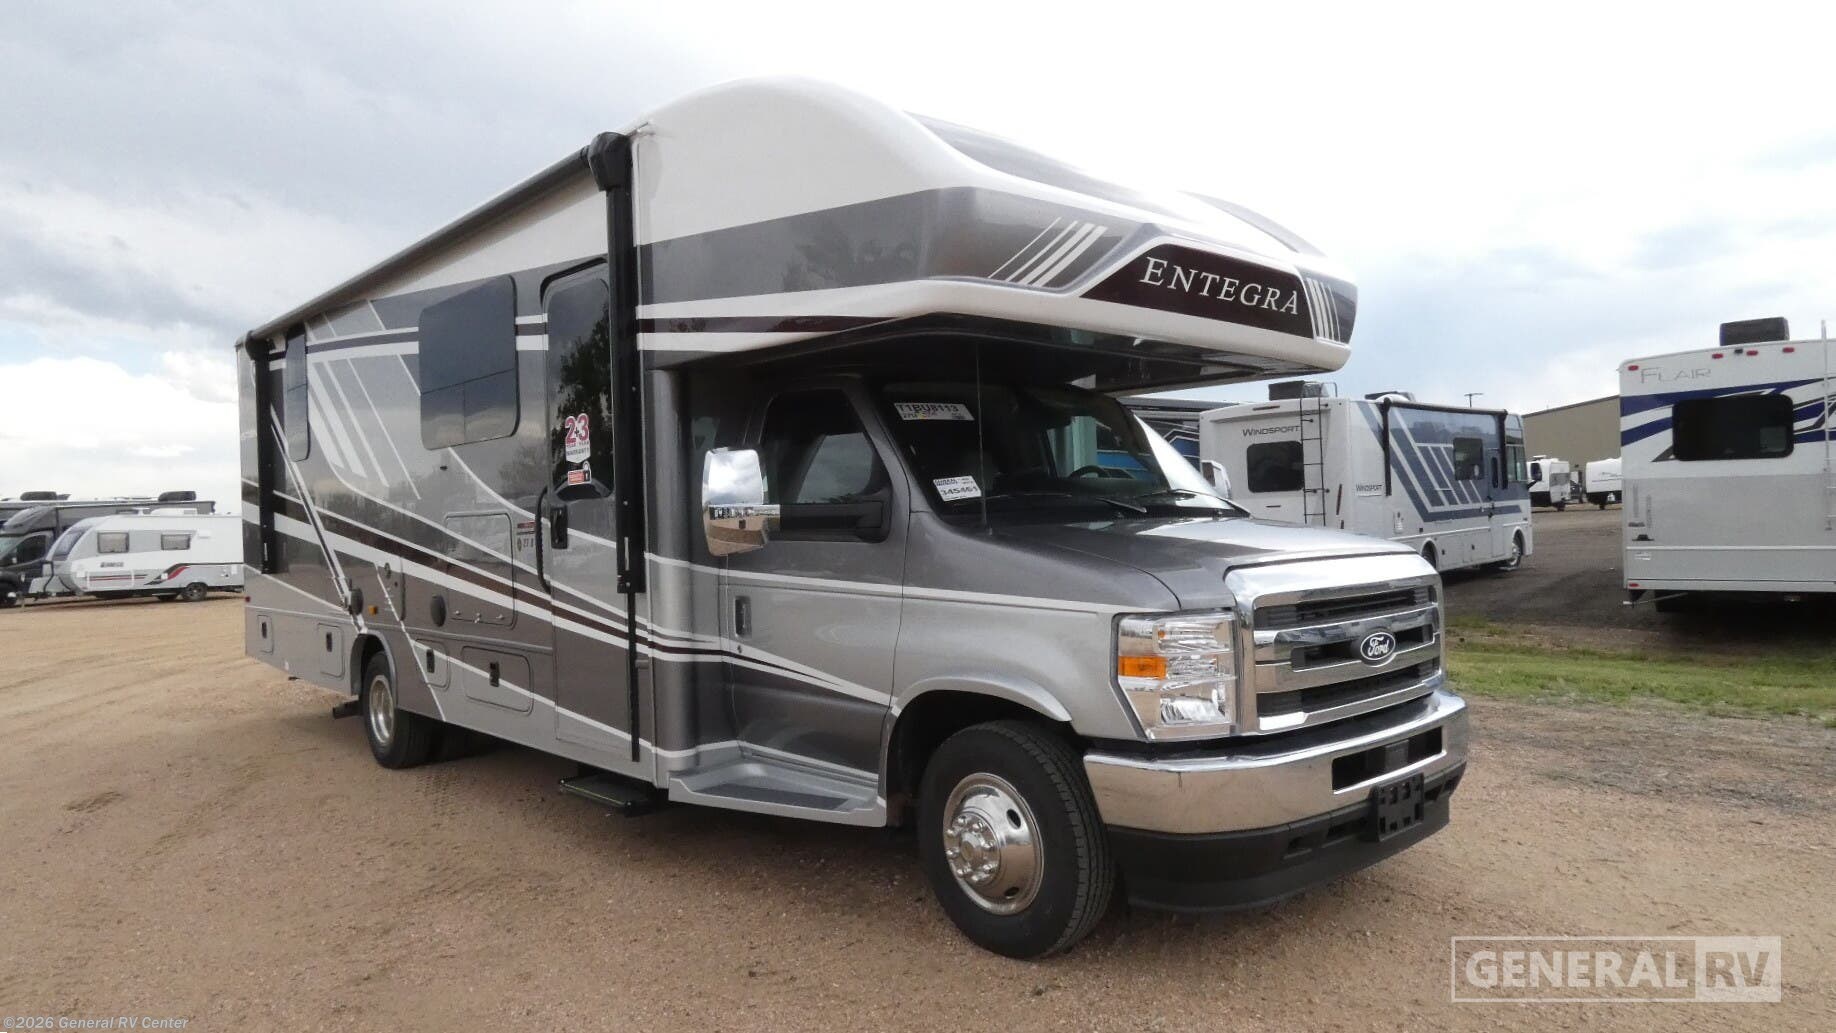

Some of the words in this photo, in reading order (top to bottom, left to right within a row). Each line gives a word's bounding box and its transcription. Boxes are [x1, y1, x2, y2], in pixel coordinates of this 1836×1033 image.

[1139, 256, 1298, 315] ENTEGRA
[1640, 366, 1712, 384] FLAIR
[1242, 425, 1301, 437] WINDSPORT
[1367, 636, 1390, 657] Ford
